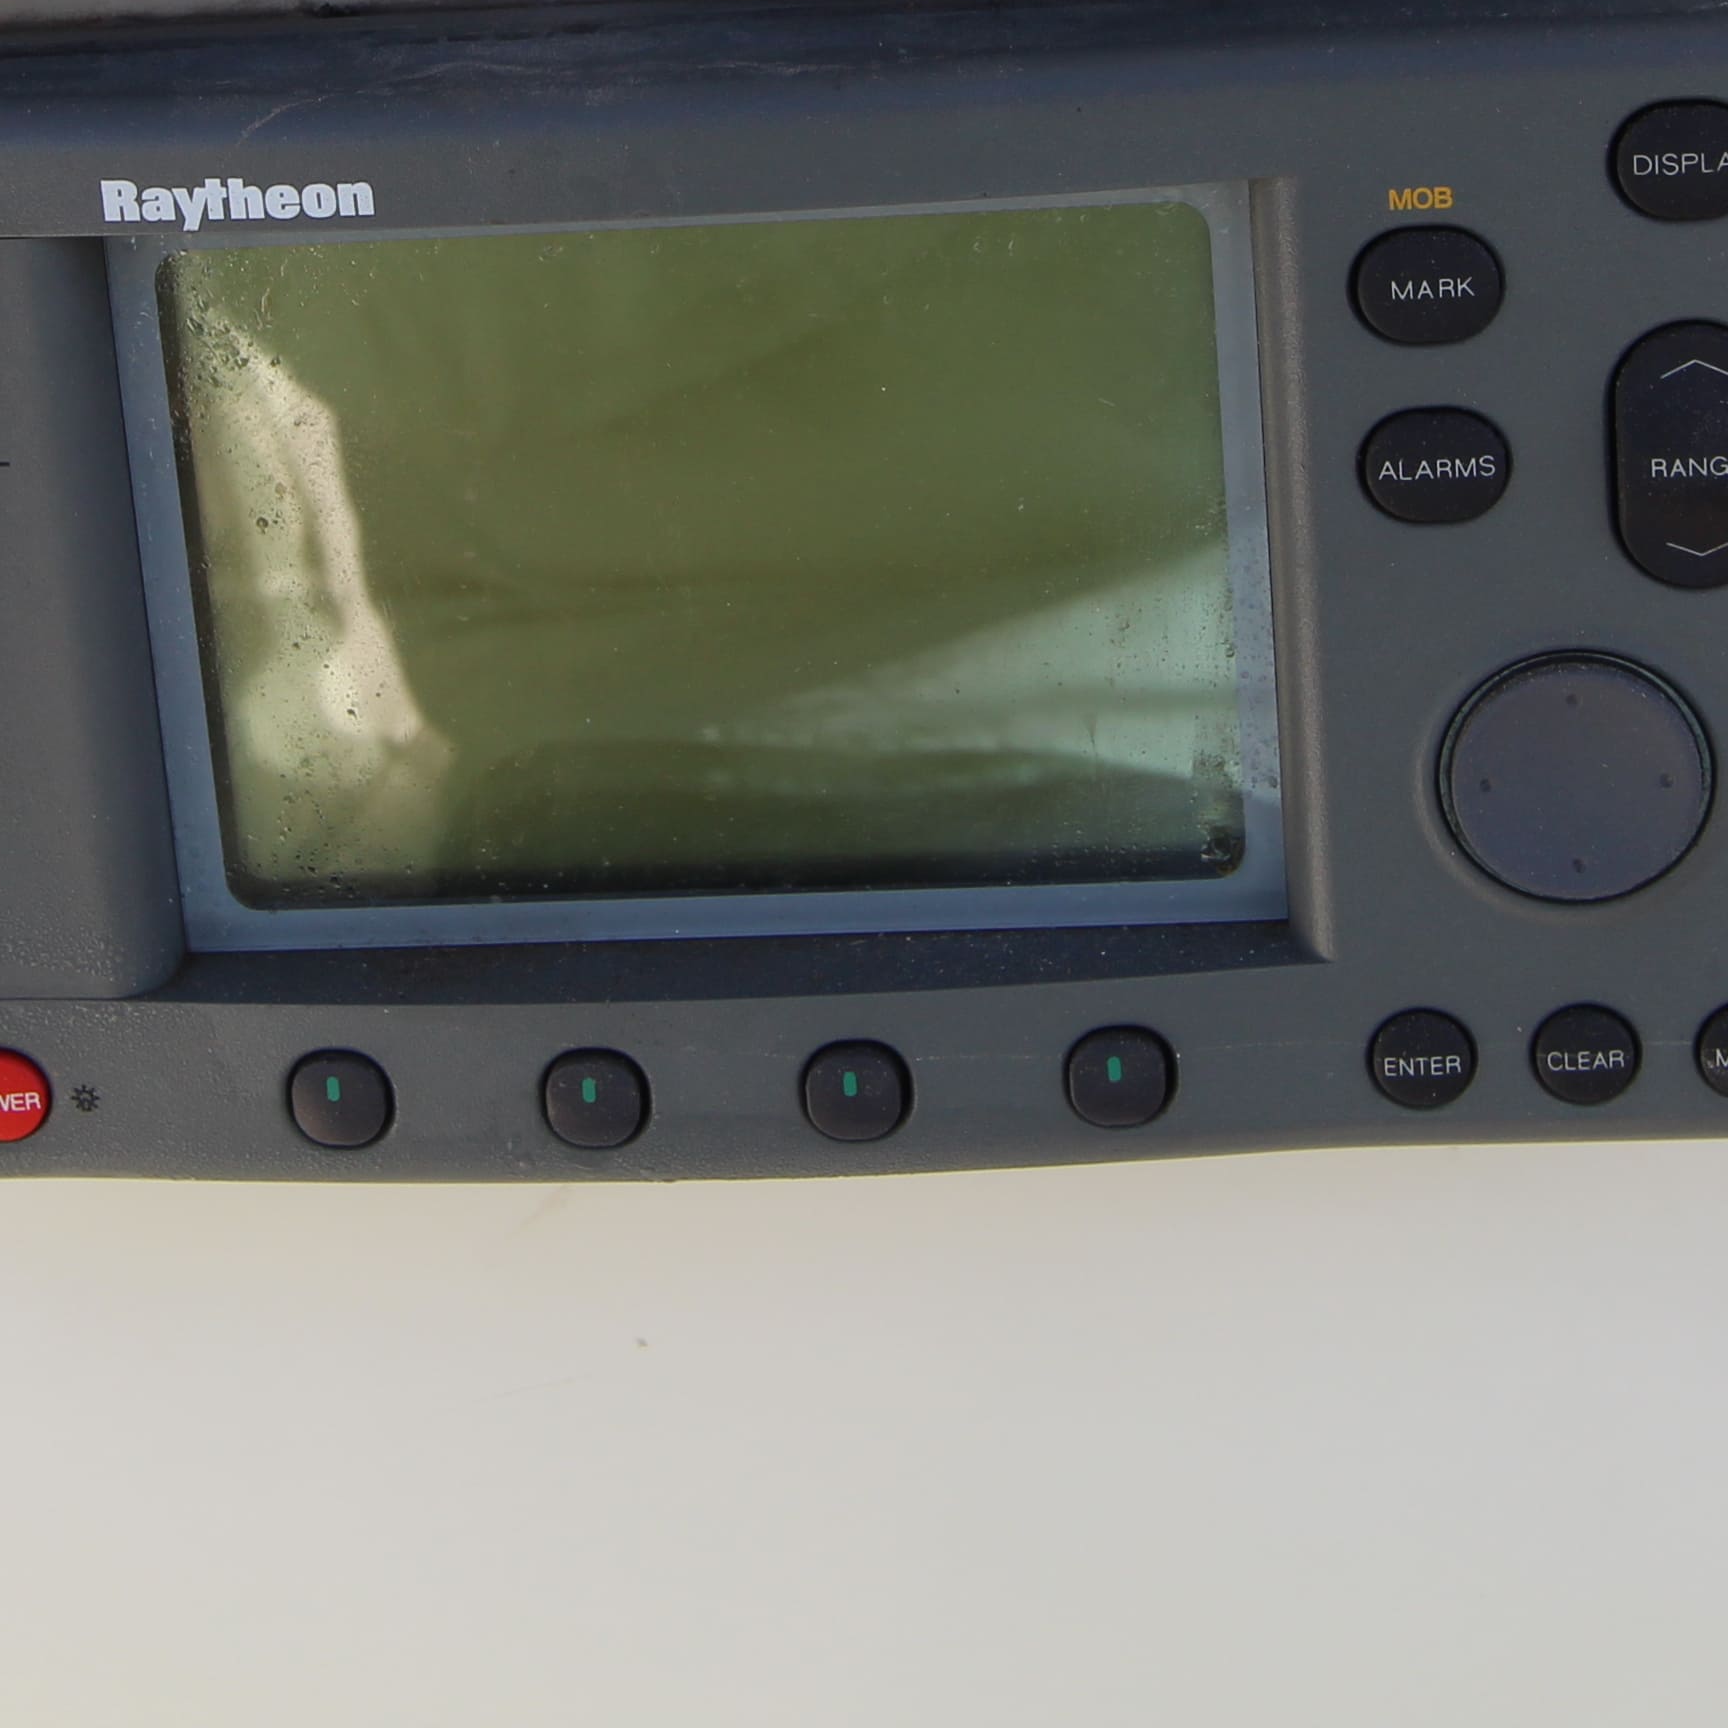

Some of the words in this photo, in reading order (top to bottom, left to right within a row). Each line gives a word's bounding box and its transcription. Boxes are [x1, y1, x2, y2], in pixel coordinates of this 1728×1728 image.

[100, 177, 375, 232] Raytheon
[1387, 185, 1454, 212] MOB
[1389, 276, 1476, 301] MARK
[1377, 454, 1497, 483] ALARMS
[1383, 1054, 1462, 1078] ENTER
[1545, 1049, 1626, 1072] CLEAR
